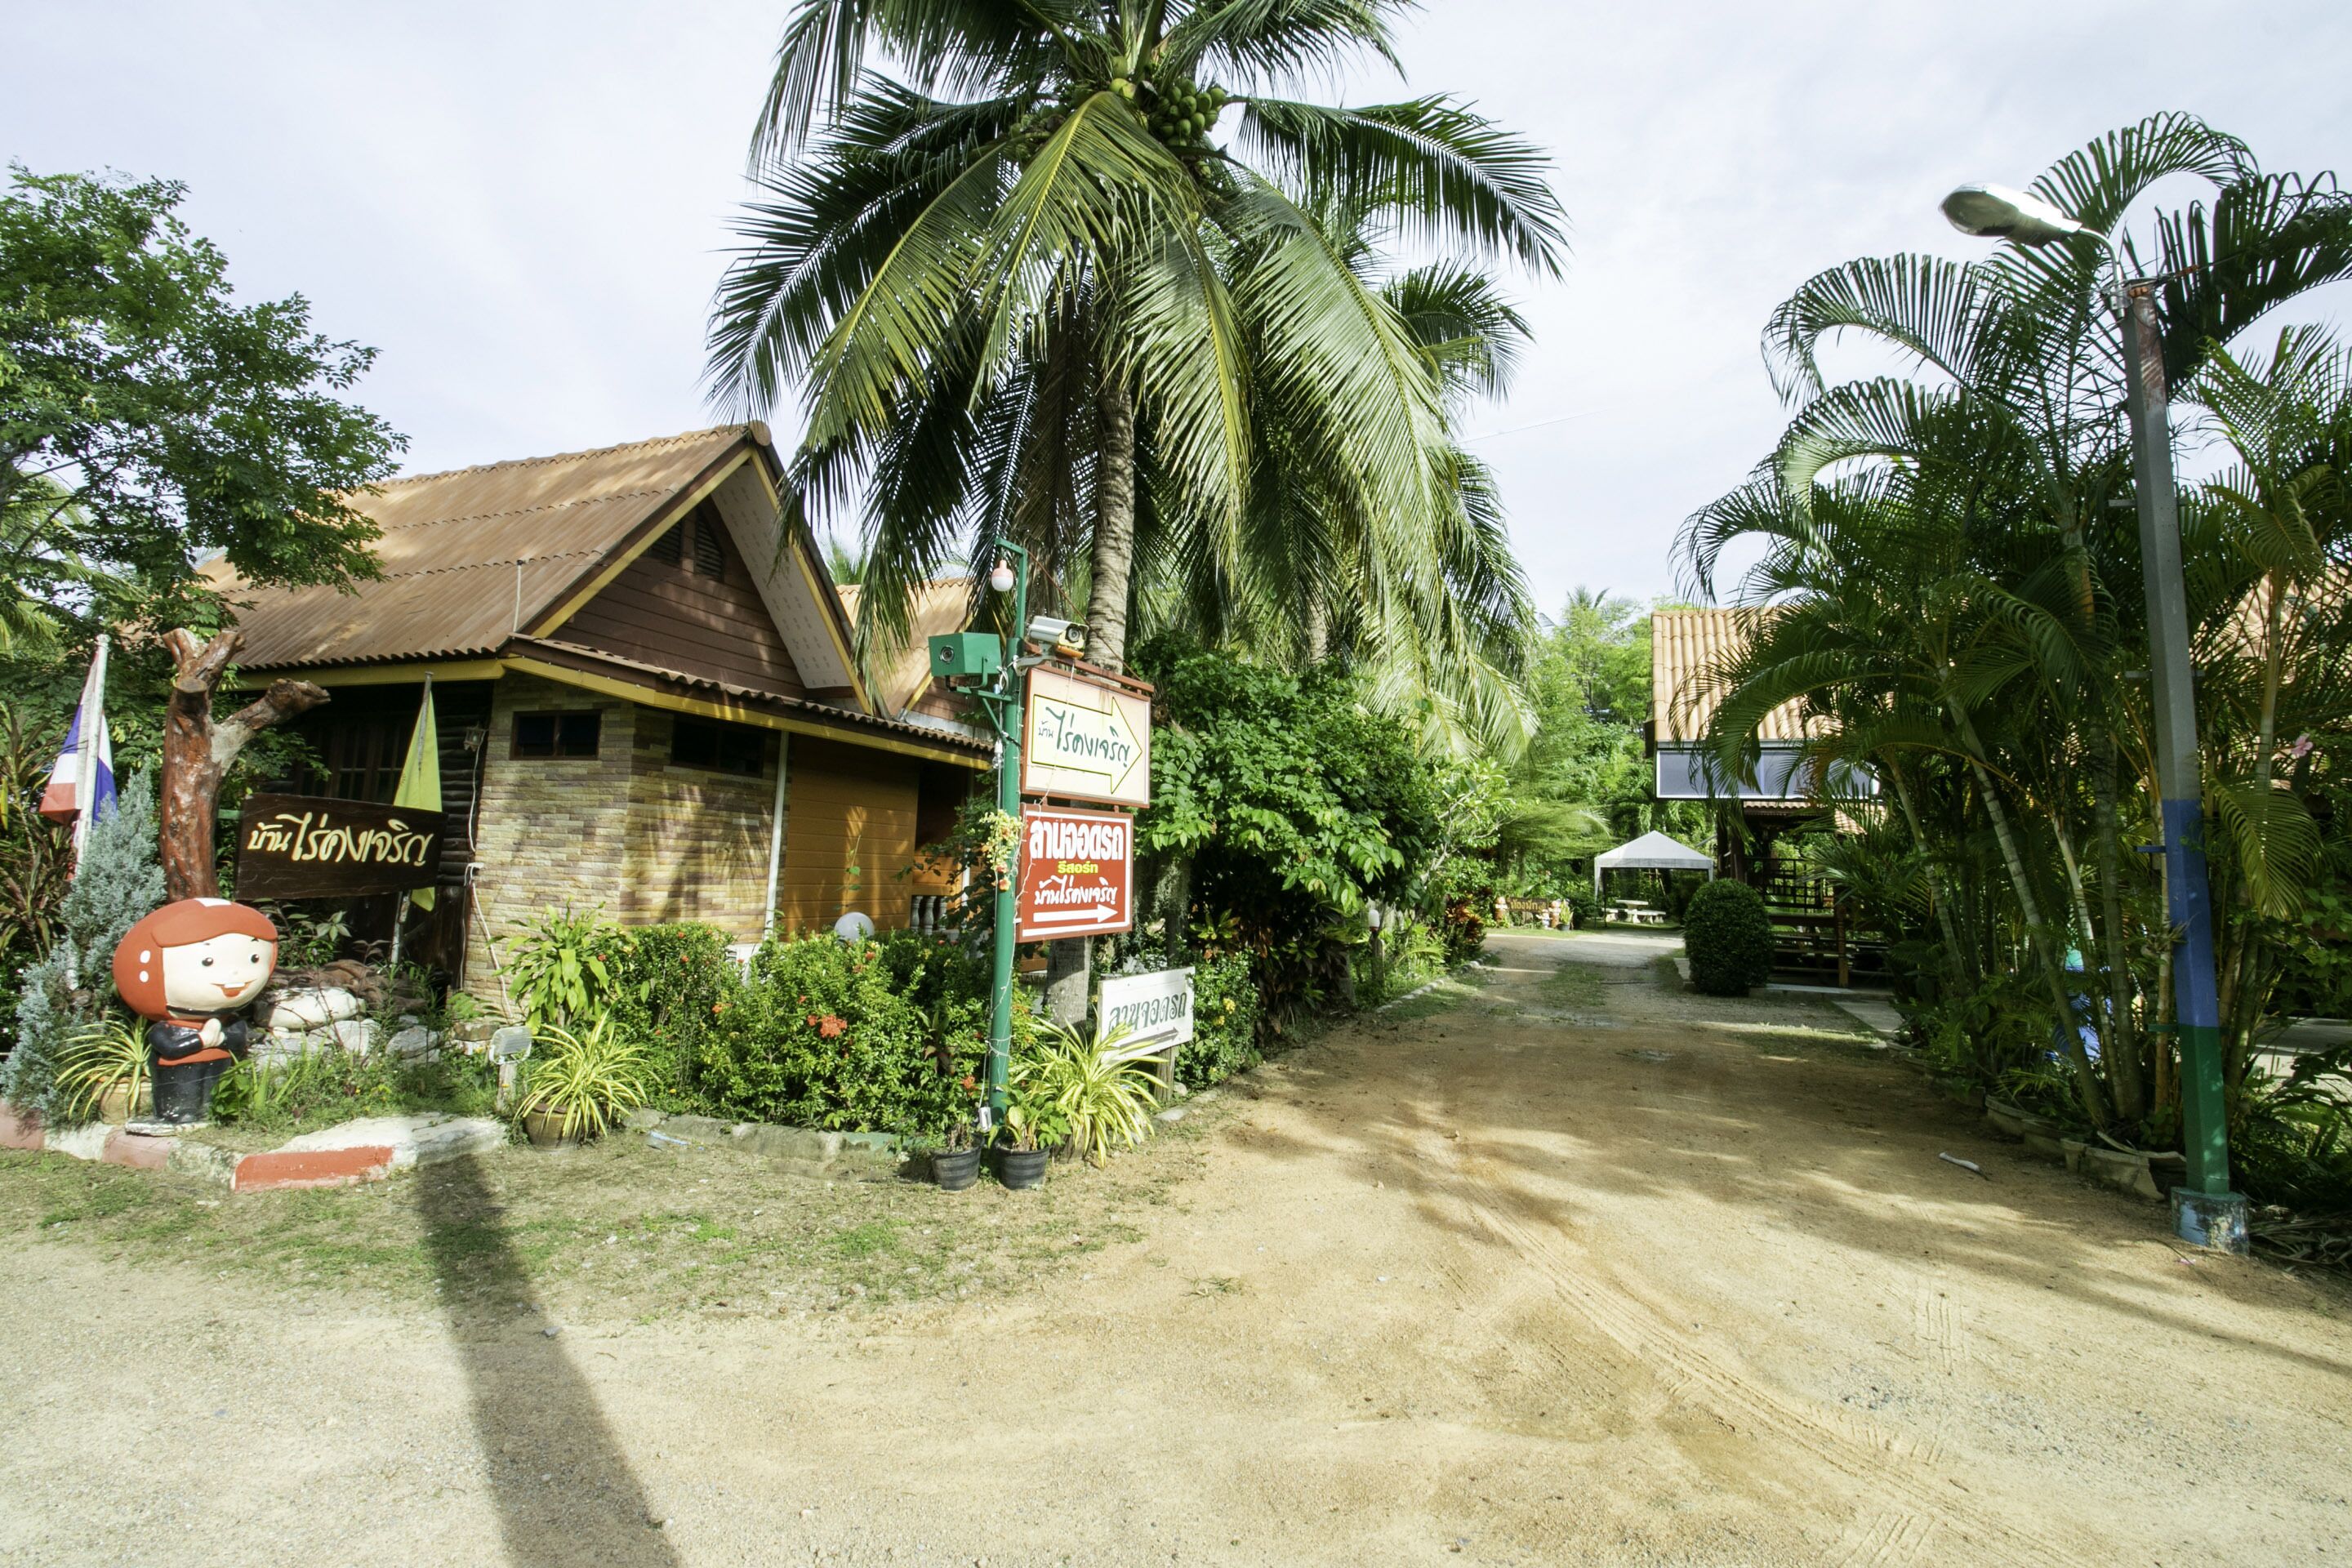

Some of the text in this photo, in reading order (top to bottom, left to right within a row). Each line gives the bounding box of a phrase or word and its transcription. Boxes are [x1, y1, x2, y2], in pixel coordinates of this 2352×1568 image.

[1030, 820, 1125, 861] ลานจอดรถ
[1058, 860, 1098, 874] รีสอร์ท
[1108, 992, 1187, 1032] ลานจอดรถ
